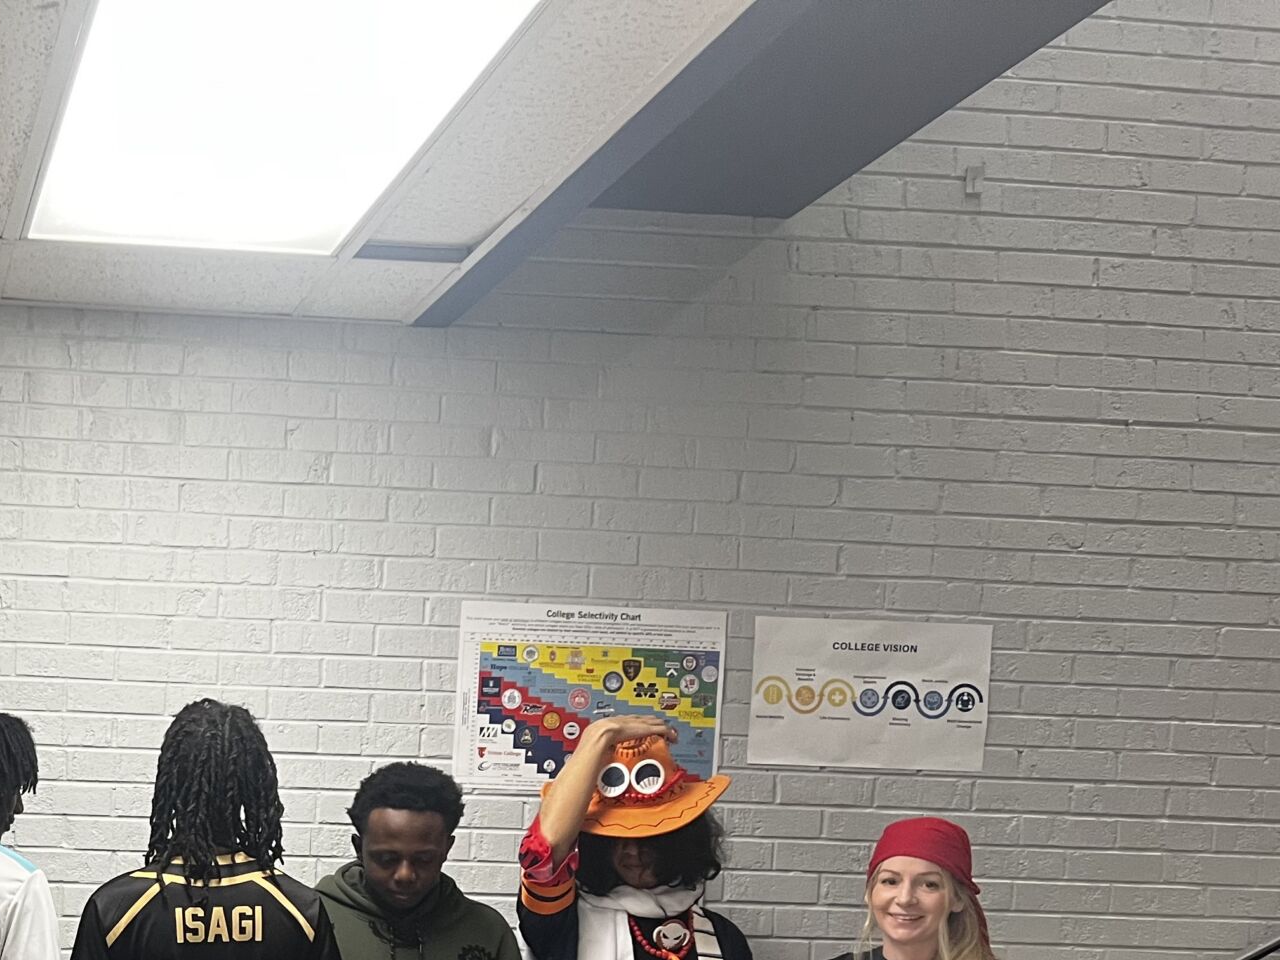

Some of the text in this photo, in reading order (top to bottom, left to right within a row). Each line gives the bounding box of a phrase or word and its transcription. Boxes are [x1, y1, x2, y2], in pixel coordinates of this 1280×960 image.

[546, 609, 641, 622] College Selectivity Chart
[832, 641, 918, 653] COLLEGE VISION
[175, 905, 262, 943] ISAGI
